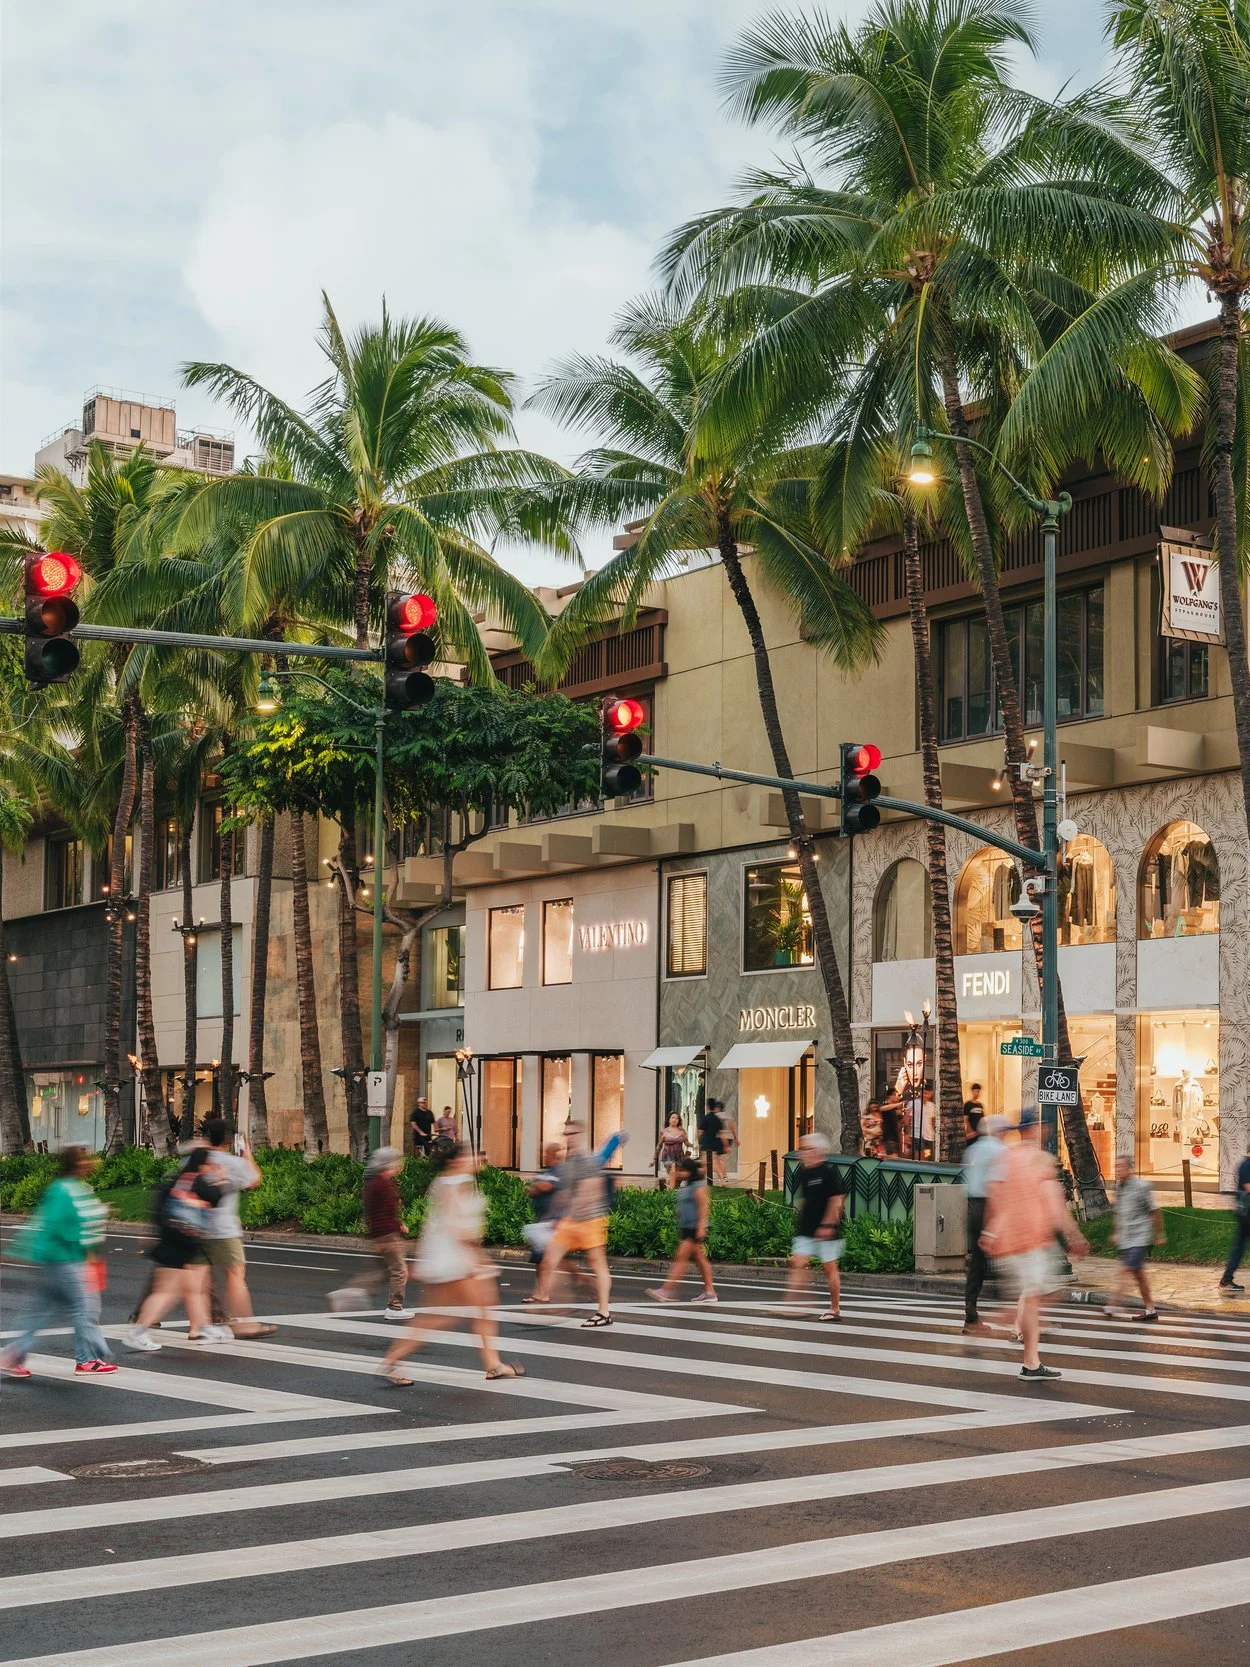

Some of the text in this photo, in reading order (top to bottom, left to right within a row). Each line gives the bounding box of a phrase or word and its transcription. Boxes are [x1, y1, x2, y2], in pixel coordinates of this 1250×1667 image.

[1181, 561, 1210, 592] W
[1173, 595, 1218, 611] WOLFGANG'S
[1175, 608, 1216, 619] STEAKHOUSE
[578, 921, 645, 950] VALENTINO
[962, 970, 1010, 997] FENDI
[739, 1006, 816, 1031] MONCLER
[1002, 1044, 1034, 1055] SEASIDE
[1039, 1090, 1076, 1102] BIKE LANE
